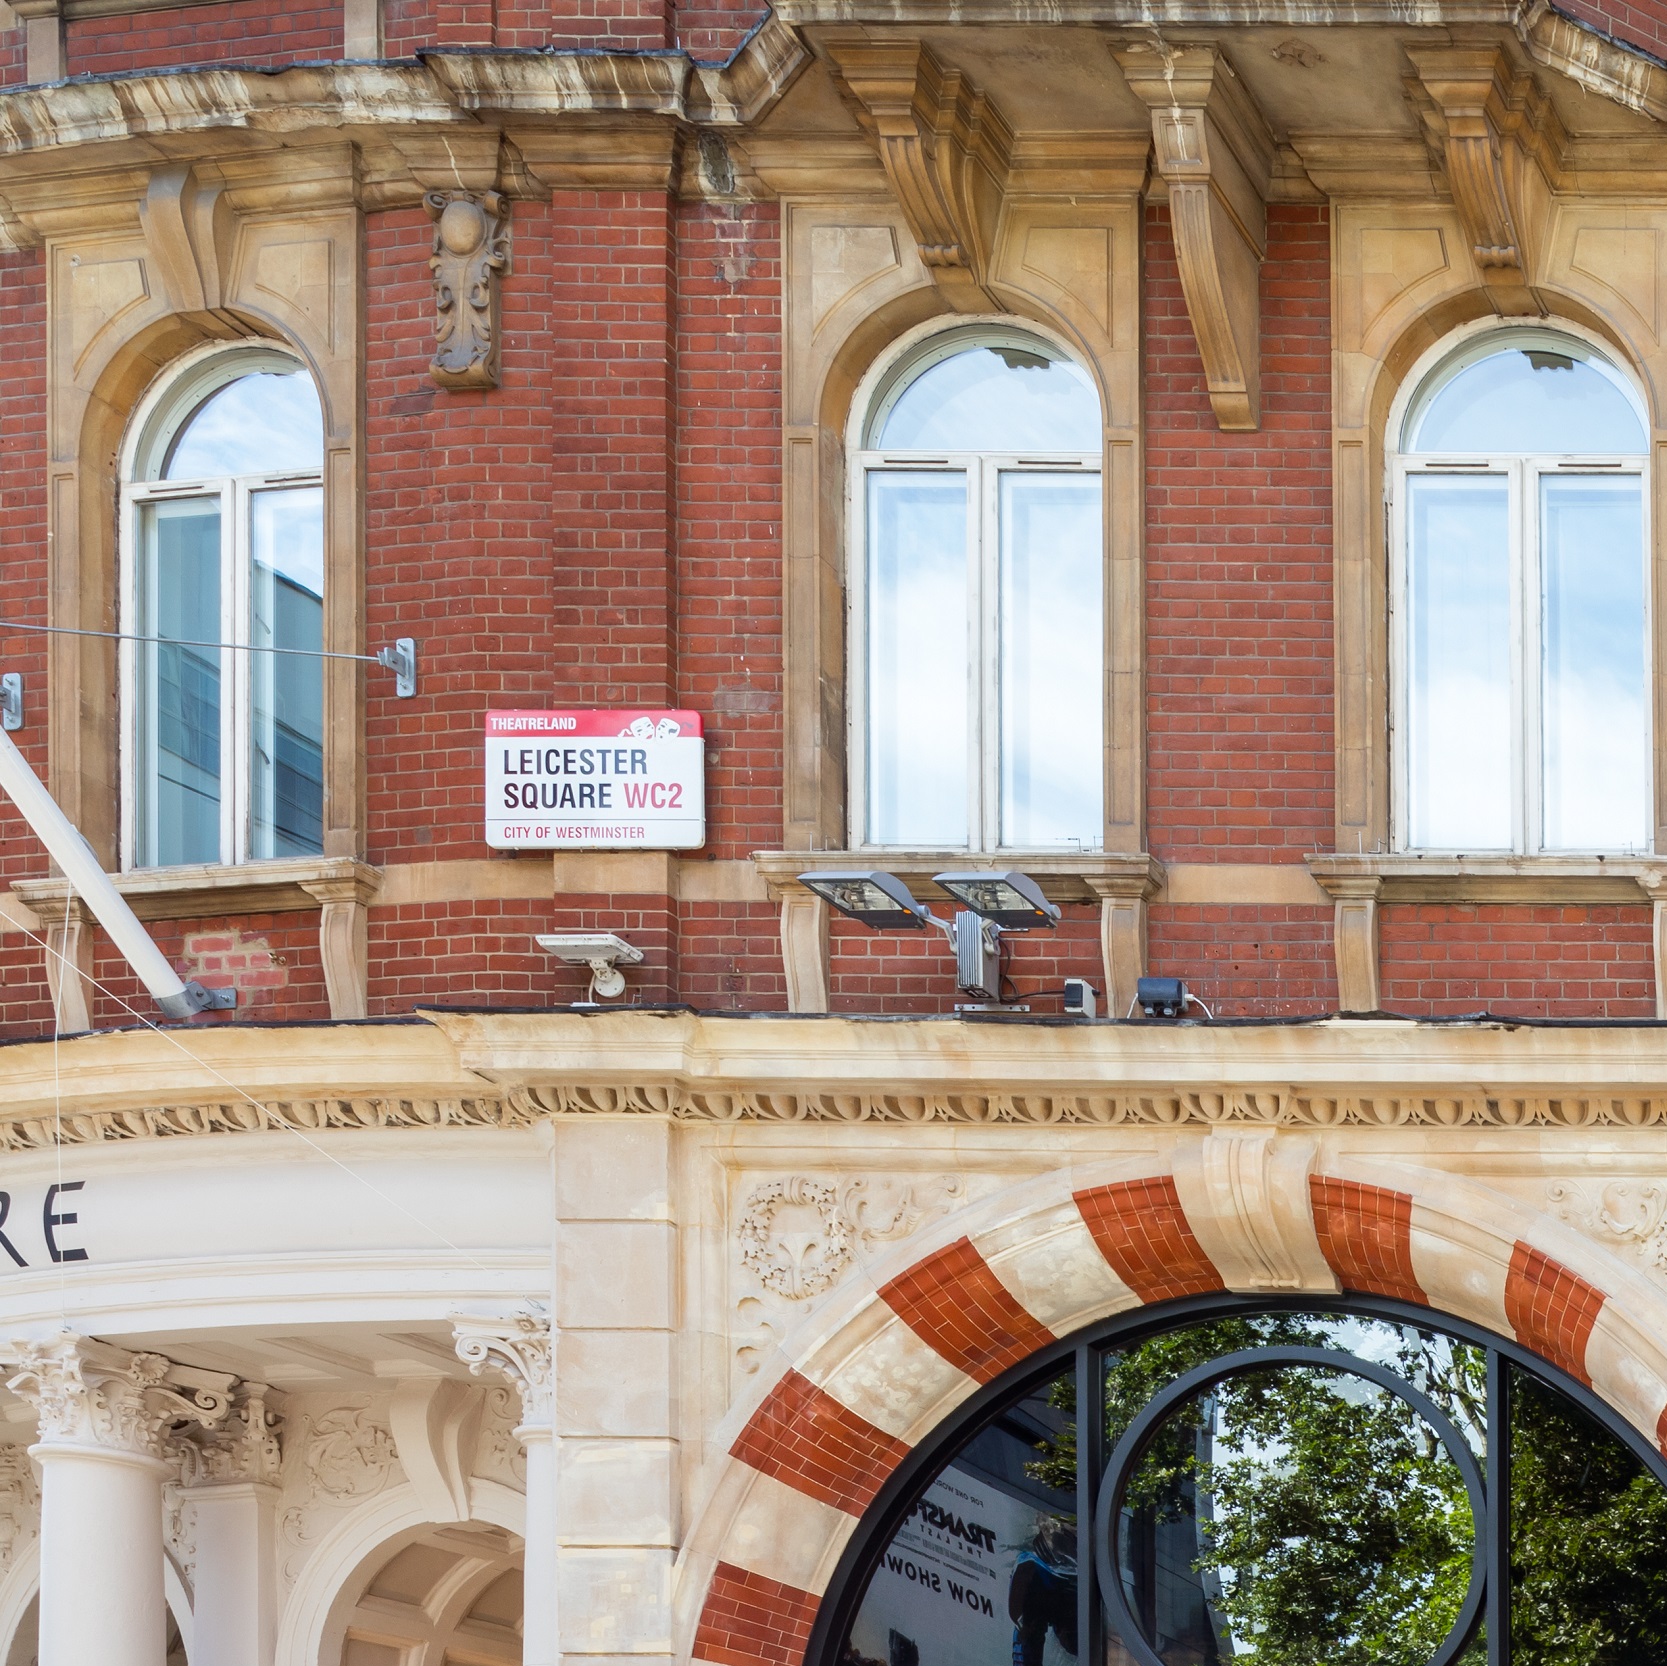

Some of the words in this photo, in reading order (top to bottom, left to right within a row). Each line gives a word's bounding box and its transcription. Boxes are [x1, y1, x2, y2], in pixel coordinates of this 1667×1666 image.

[490, 717, 577, 730] THEATRELAND
[503, 749, 648, 775] LEICESTER
[504, 782, 612, 809] SQUARE
[624, 782, 683, 809] WC2
[504, 826, 530, 839] CITY
[535, 826, 551, 839] OF
[556, 826, 645, 839] WESTMINSTER
